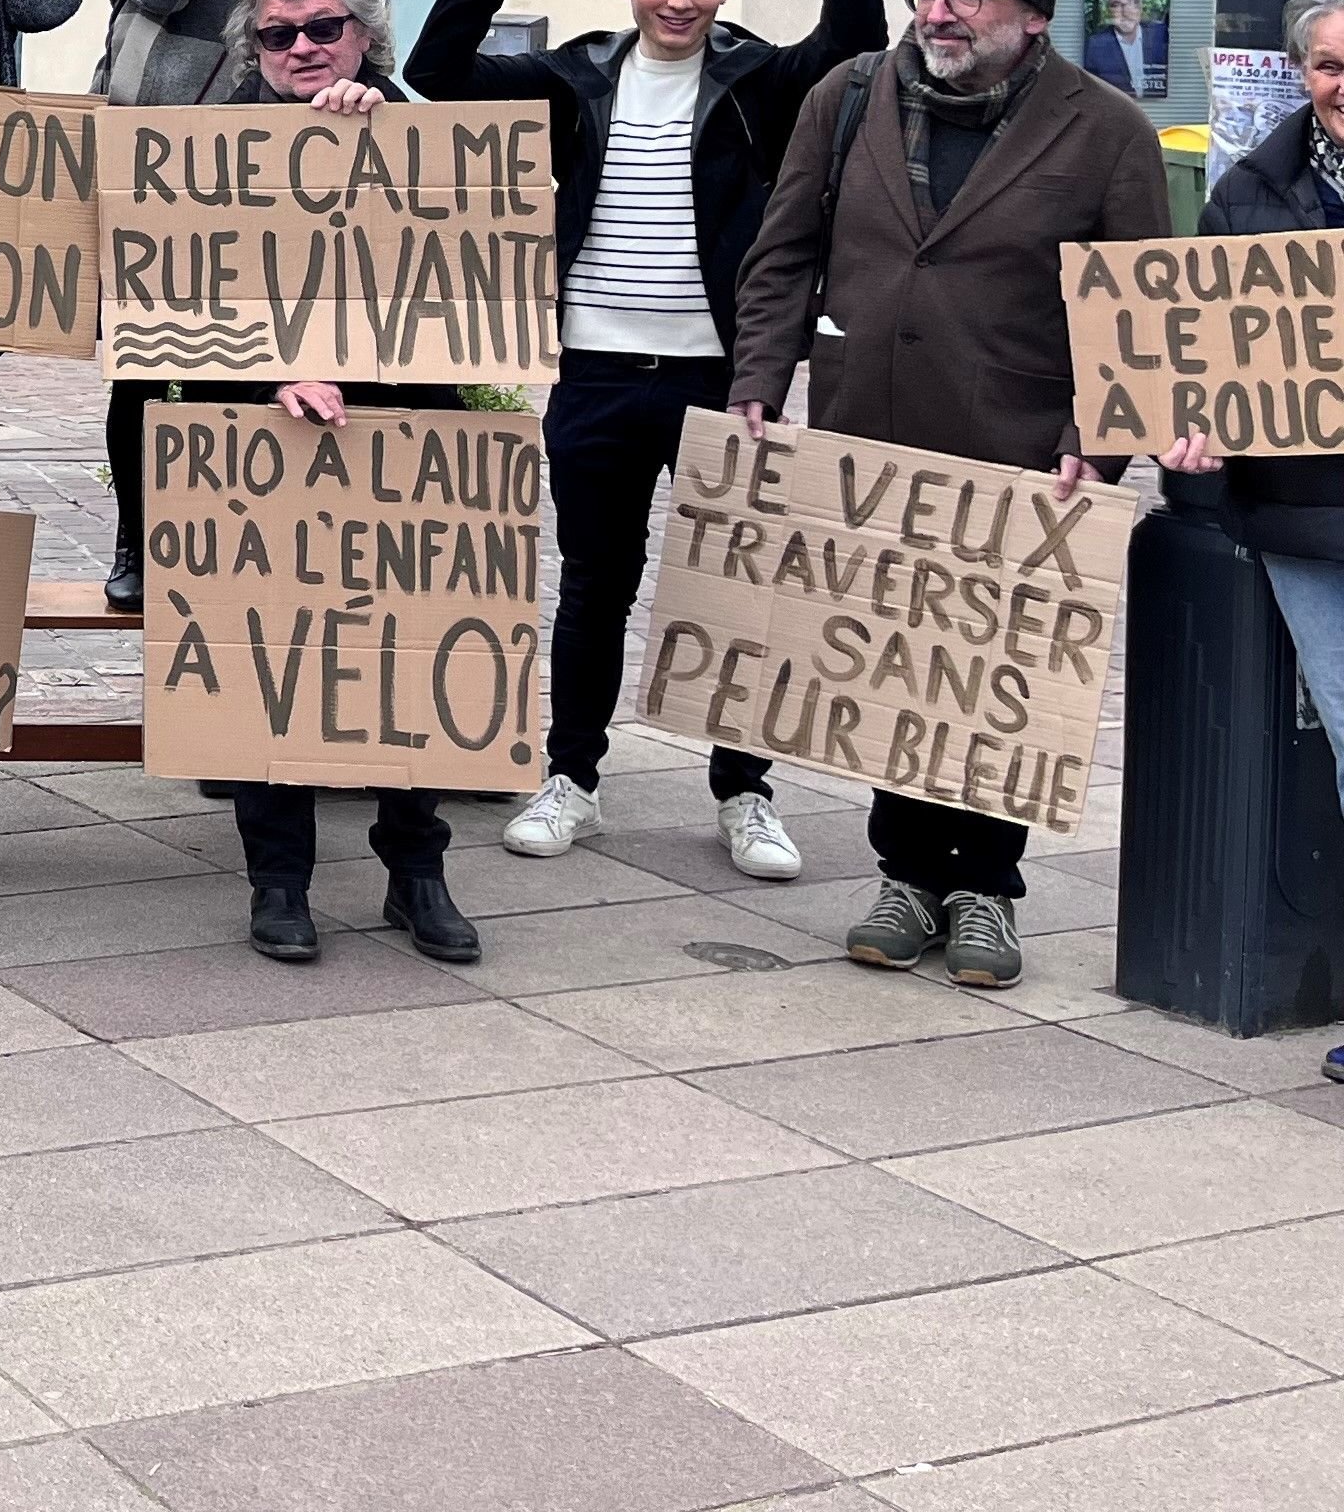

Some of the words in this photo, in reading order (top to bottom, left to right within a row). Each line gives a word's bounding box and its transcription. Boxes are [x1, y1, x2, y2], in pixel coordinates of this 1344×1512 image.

[1261, 56, 1271, 68] A
[134, 126, 276, 207] RUE
[289, 120, 547, 219] CALME
[113, 227, 239, 321] RUE
[263, 211, 558, 369] VIVANTE
[1133, 238, 1344, 302] QUAN
[1115, 306, 1208, 375] LE
[1096, 363, 1146, 441] À
[155, 408, 284, 496] PRIO
[371, 421, 540, 517] L'AUTO
[684, 434, 797, 516] JE
[839, 453, 1093, 592] VEUX
[149, 518, 217, 577] OU
[232, 499, 272, 577] À
[296, 511, 540, 603] L'ENFANT
[677, 503, 1102, 684] TRAVERSER
[164, 589, 221, 695] À
[813, 615, 1030, 733] SANS
[647, 620, 863, 770] PEUR
[885, 709, 1083, 833] BLEUE
